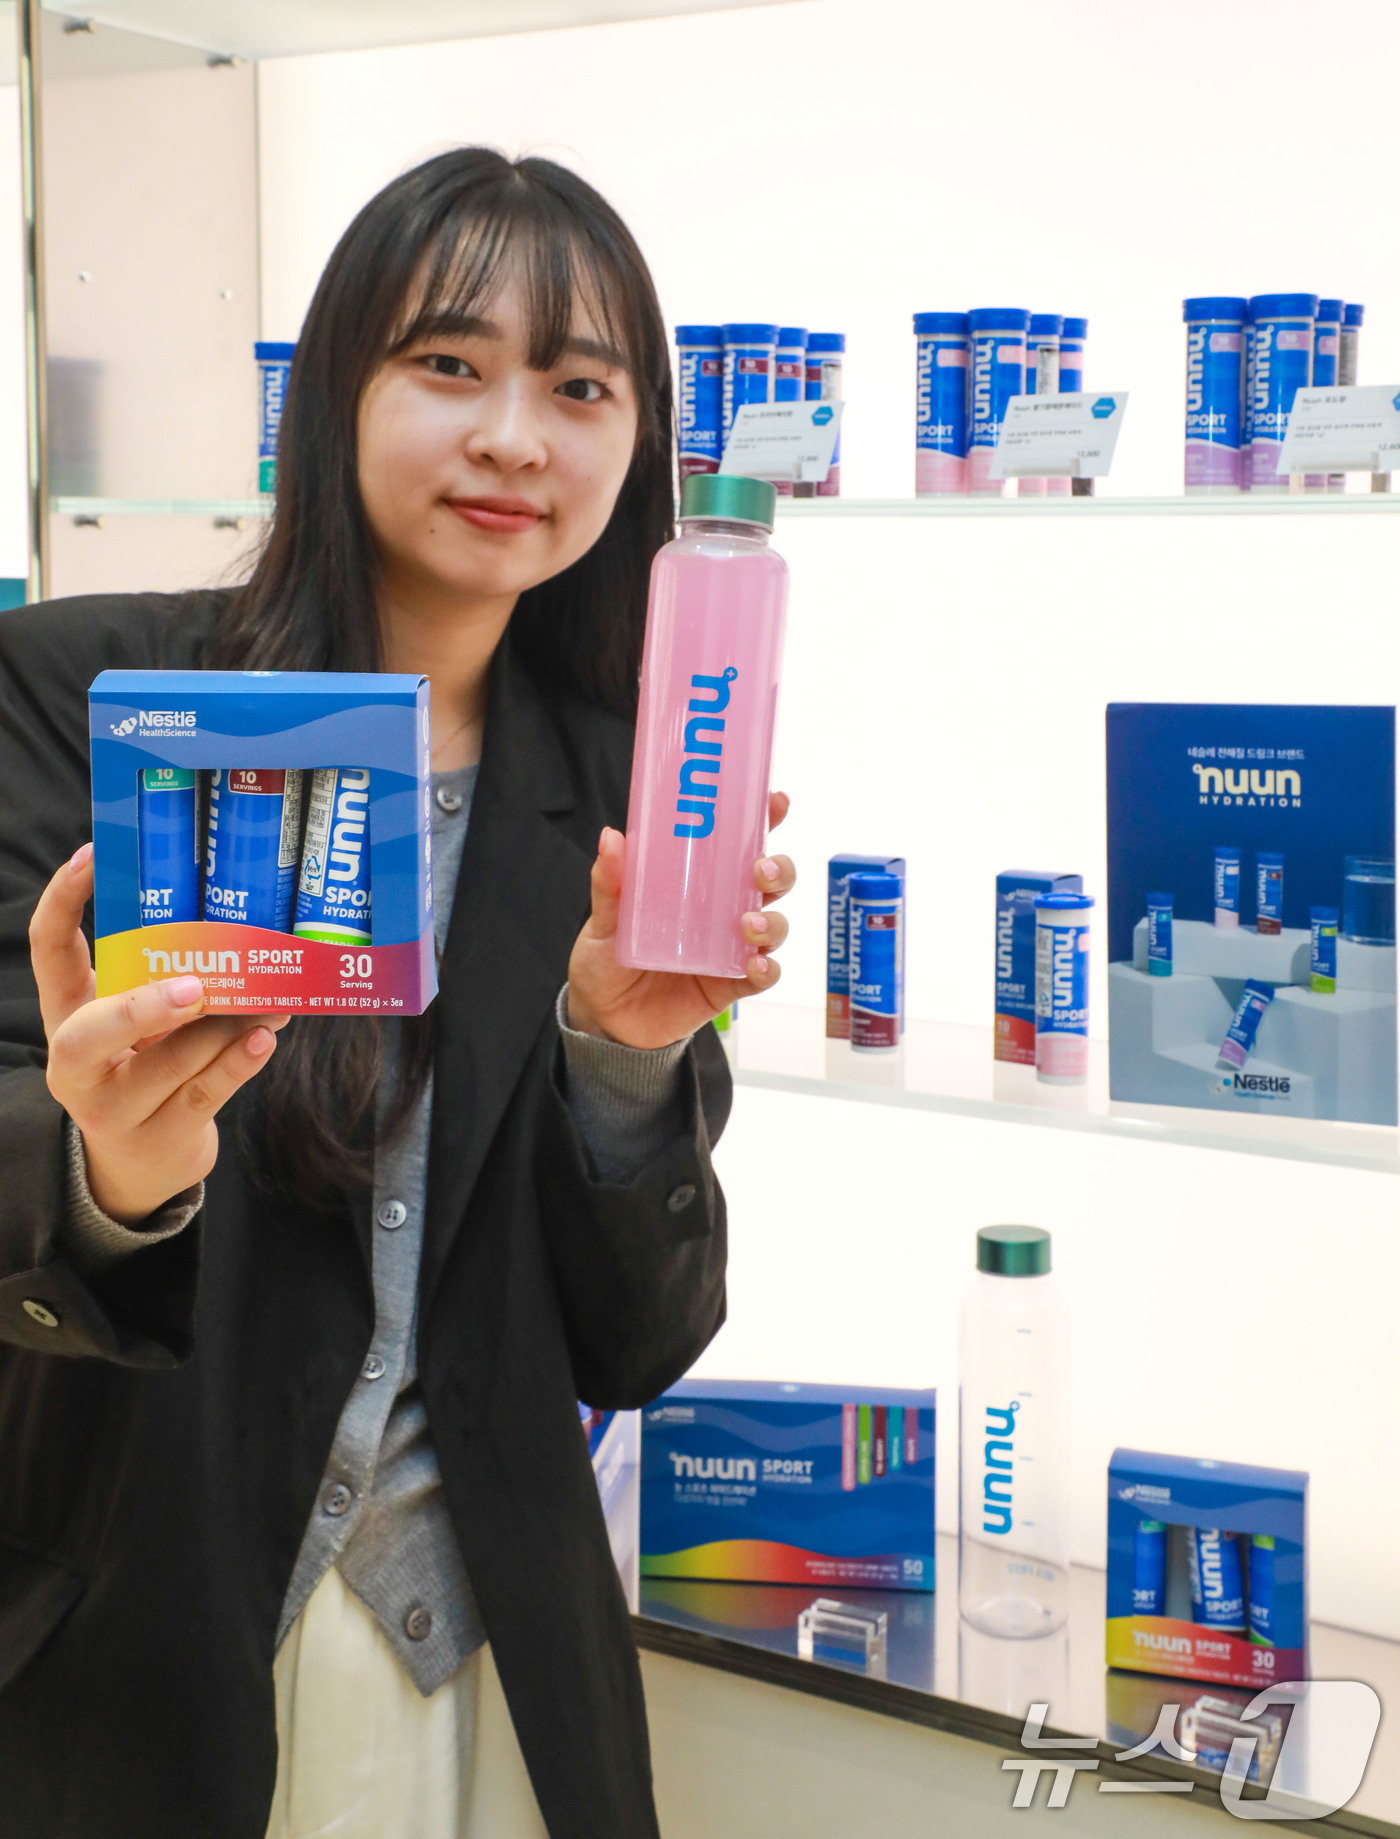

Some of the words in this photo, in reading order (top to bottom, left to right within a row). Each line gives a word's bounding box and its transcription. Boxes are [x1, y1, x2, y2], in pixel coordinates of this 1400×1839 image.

[1187, 413, 1227, 426] SPORT
[917, 425, 954, 436] SPORT
[139, 729, 197, 737] HealthScience
[673, 666, 738, 839] nuun
[239, 771, 257, 784] 10
[1192, 763, 1302, 796] nuun
[233, 783, 263, 792] SERVINGS
[1199, 795, 1302, 808] HYDRATION
[142, 947, 241, 973] nuun
[247, 949, 304, 964] SPORT
[339, 954, 373, 978] 30
[248, 965, 303, 974] HYDRATION
[340, 981, 373, 990] Serving
[210, 996, 231, 1006] DRINK
[233, 996, 272, 1007] TABLETS/10
[274, 997, 303, 1007] TABLETS
[309, 997, 322, 1007] NET
[324, 997, 335, 1007] WT
[337, 997, 347, 1007] 1.8
[348, 998, 358, 1007] OZ
[359, 998, 371, 1008] (52
[373, 998, 381, 1009] g)
[391, 998, 404, 1007] 3ea
[669, 1451, 757, 1481] nuun
[762, 1459, 814, 1475] SPORT
[983, 1401, 1020, 1535] nuun
[903, 1559, 924, 1575] 50
[1252, 1650, 1275, 1669] 30
